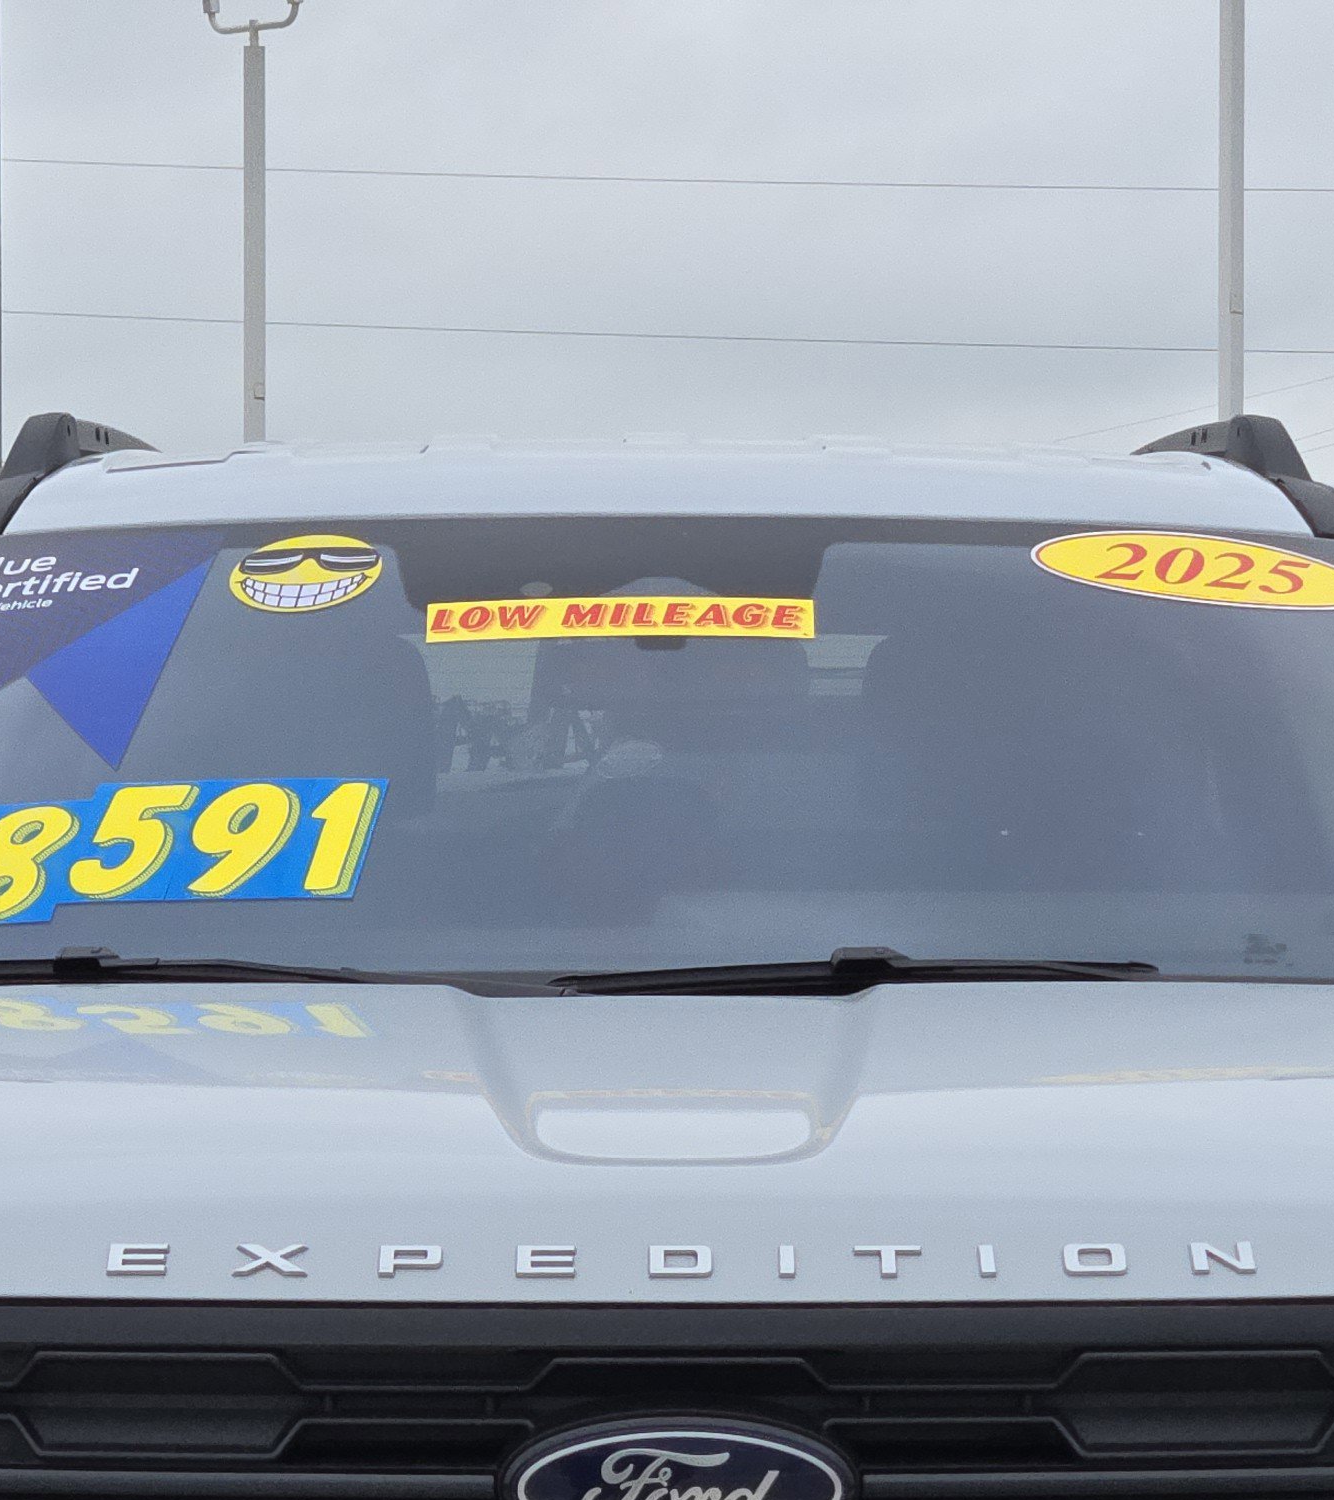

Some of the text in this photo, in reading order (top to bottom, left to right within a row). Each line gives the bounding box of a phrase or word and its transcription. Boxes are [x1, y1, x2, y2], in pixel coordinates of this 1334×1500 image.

[1094, 543, 1311, 594] 2025
[430, 602, 807, 633] LOW MILEAGE
[106, 1241, 1258, 1279] EXPEDITION
